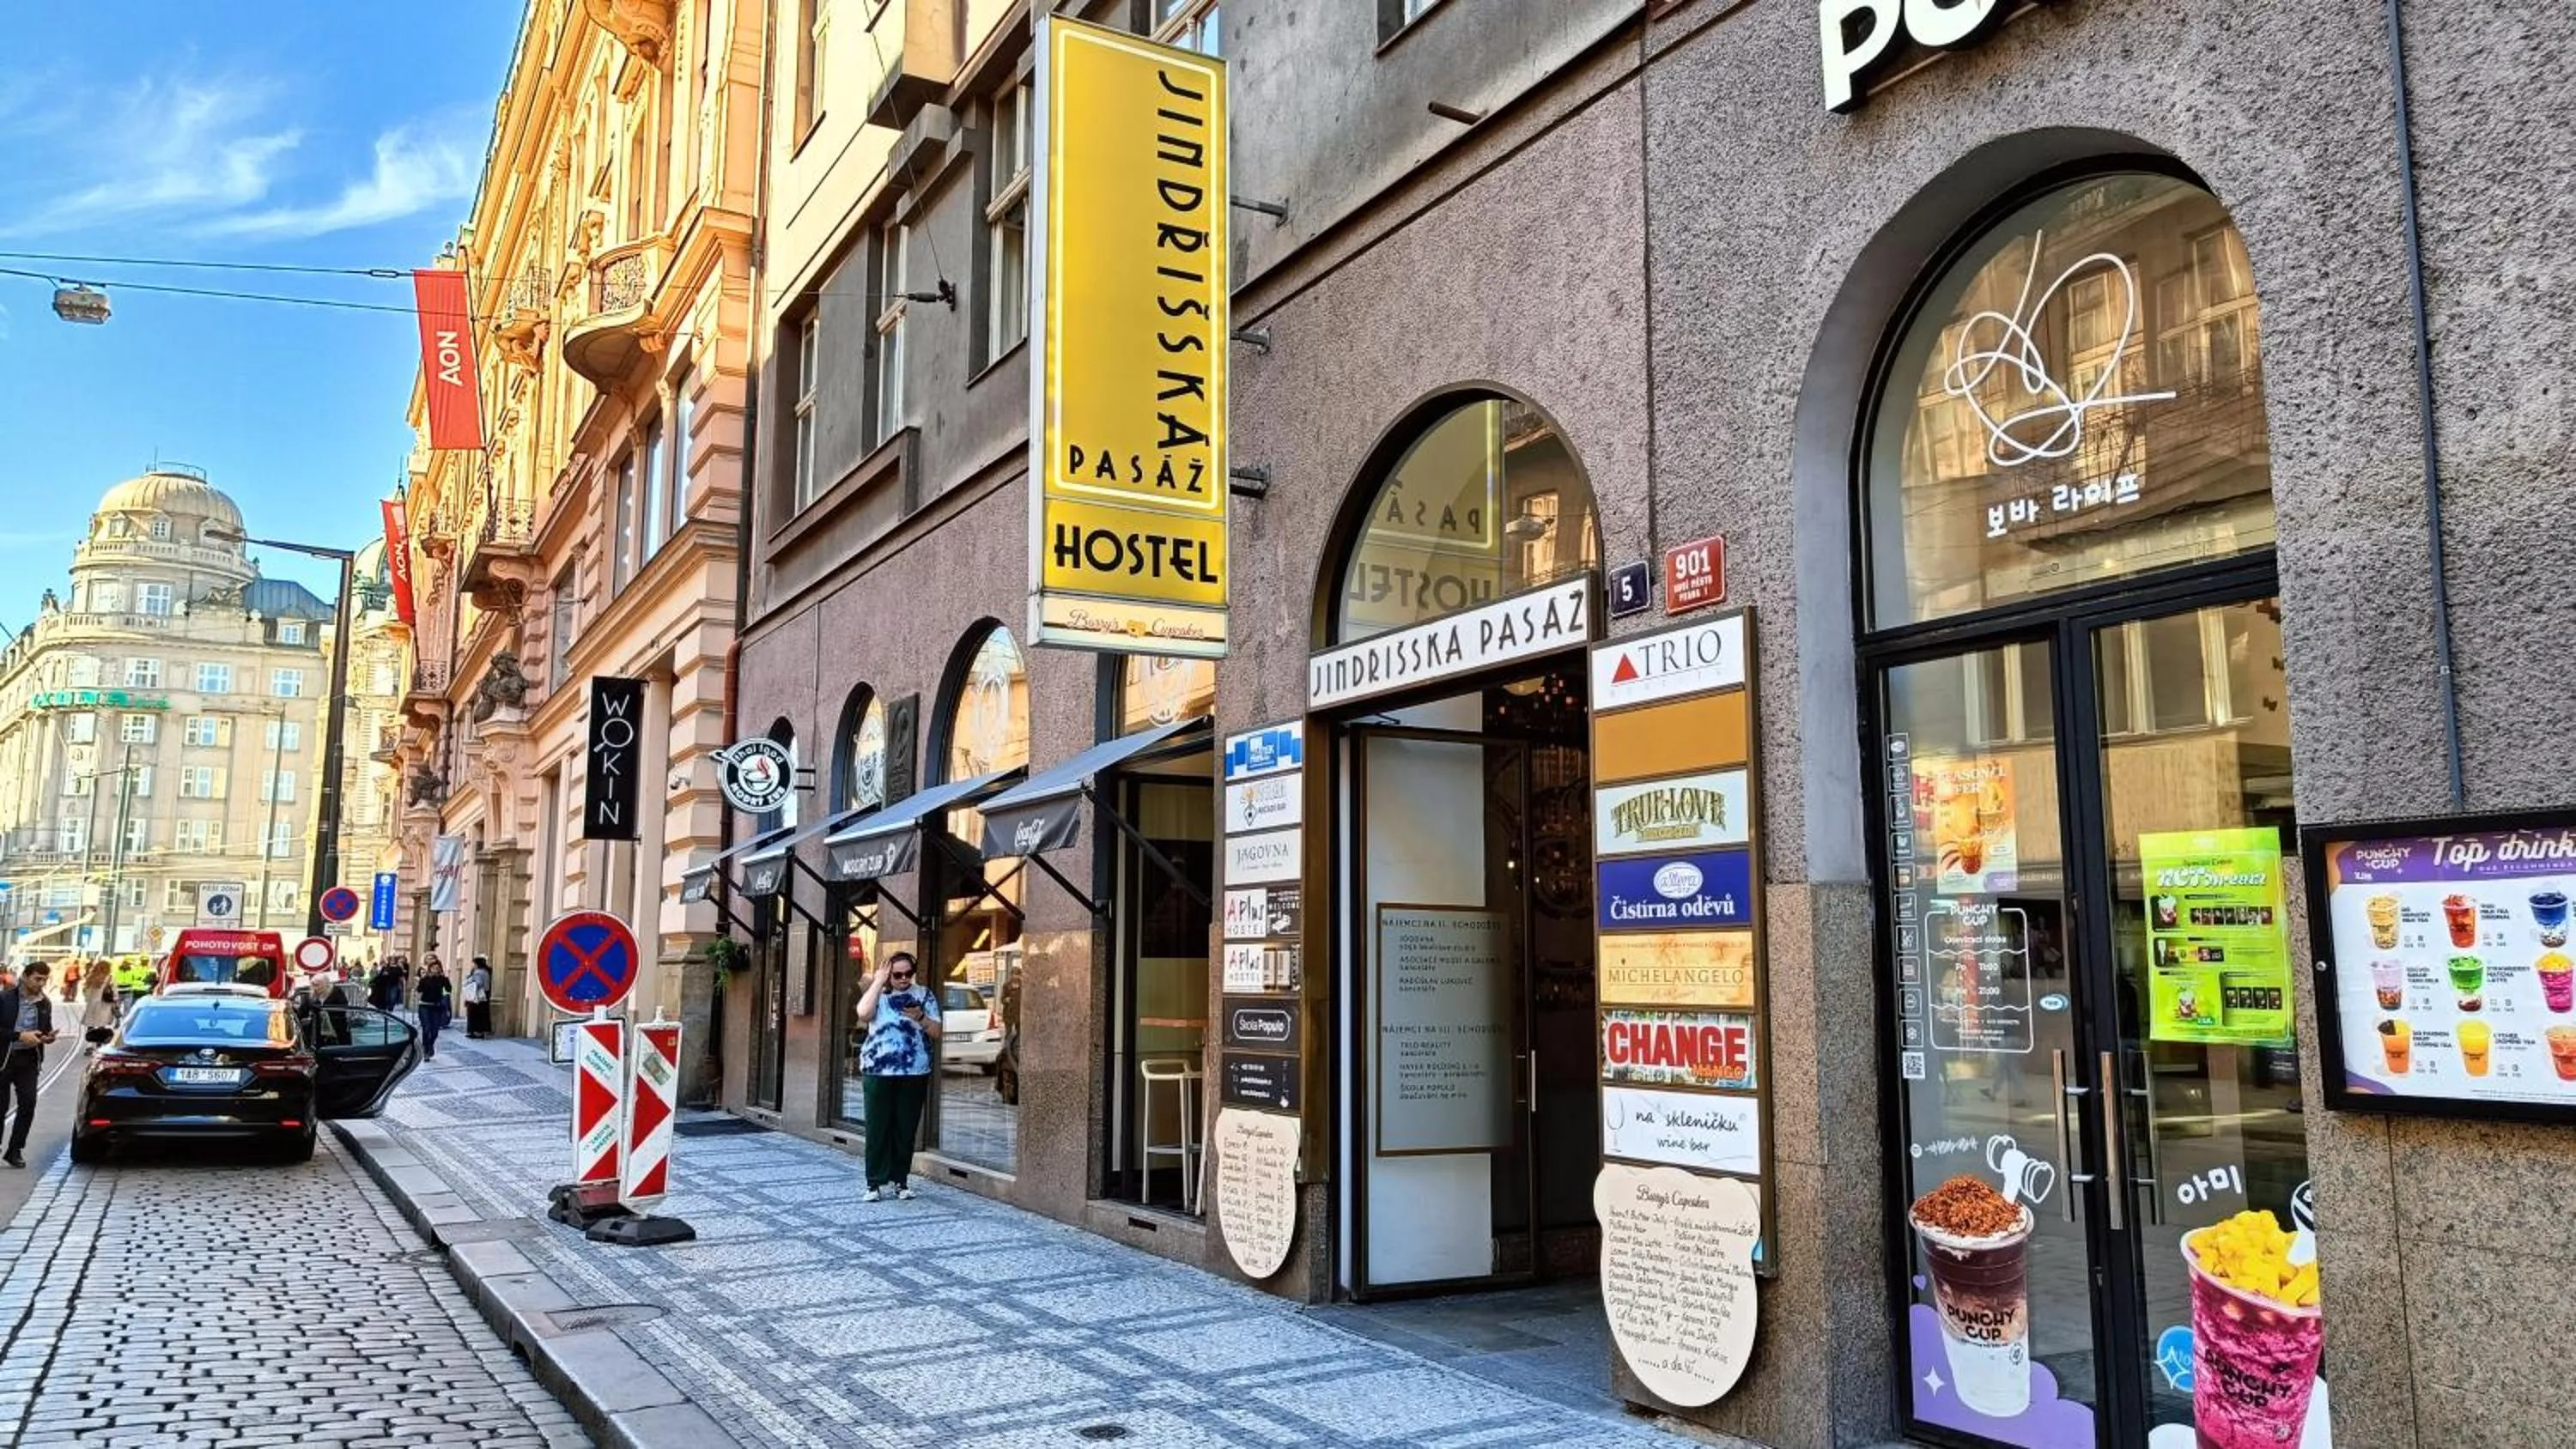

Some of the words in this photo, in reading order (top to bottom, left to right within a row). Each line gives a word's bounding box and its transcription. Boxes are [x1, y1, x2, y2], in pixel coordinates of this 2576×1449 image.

[436, 330, 463, 386] AON
[1069, 444, 1205, 493] PASÁŽ
[1986, 499, 2038, 538] 보바
[394, 543, 408, 584] AON
[1054, 524, 1218, 584] HOSTEL
[1675, 546, 1711, 579] 901
[1621, 575, 1633, 602] 5
[1151, 617, 1205, 639] Cupcakes
[1637, 629, 1722, 676] TRIO
[594, 692, 634, 825] WOKIN
[734, 743, 756, 764] thai
[759, 743, 784, 764] food
[2356, 847, 2411, 860] PUNCHY
[2371, 858, 2399, 870] CUP
[2431, 835, 2490, 872] Top
[1610, 894, 1677, 919] Čistírna
[1681, 893, 1735, 917] oděvů
[1950, 904, 1998, 916] PUNCHY
[1607, 967, 1745, 984] MICHELANGELO
[1607, 1022, 1747, 1072] CHANGE
[1636, 1110, 1655, 1122] na
[1665, 1109, 1738, 1132] skleničku
[1657, 1134, 1686, 1149] wine
[1688, 1136, 1711, 1152] bar
[2178, 1165, 2242, 1204] 아미
[1947, 1303, 2015, 1327] PUNCHY
[1965, 1325, 2002, 1341] CUP
[2221, 1379, 2269, 1408] CUP
